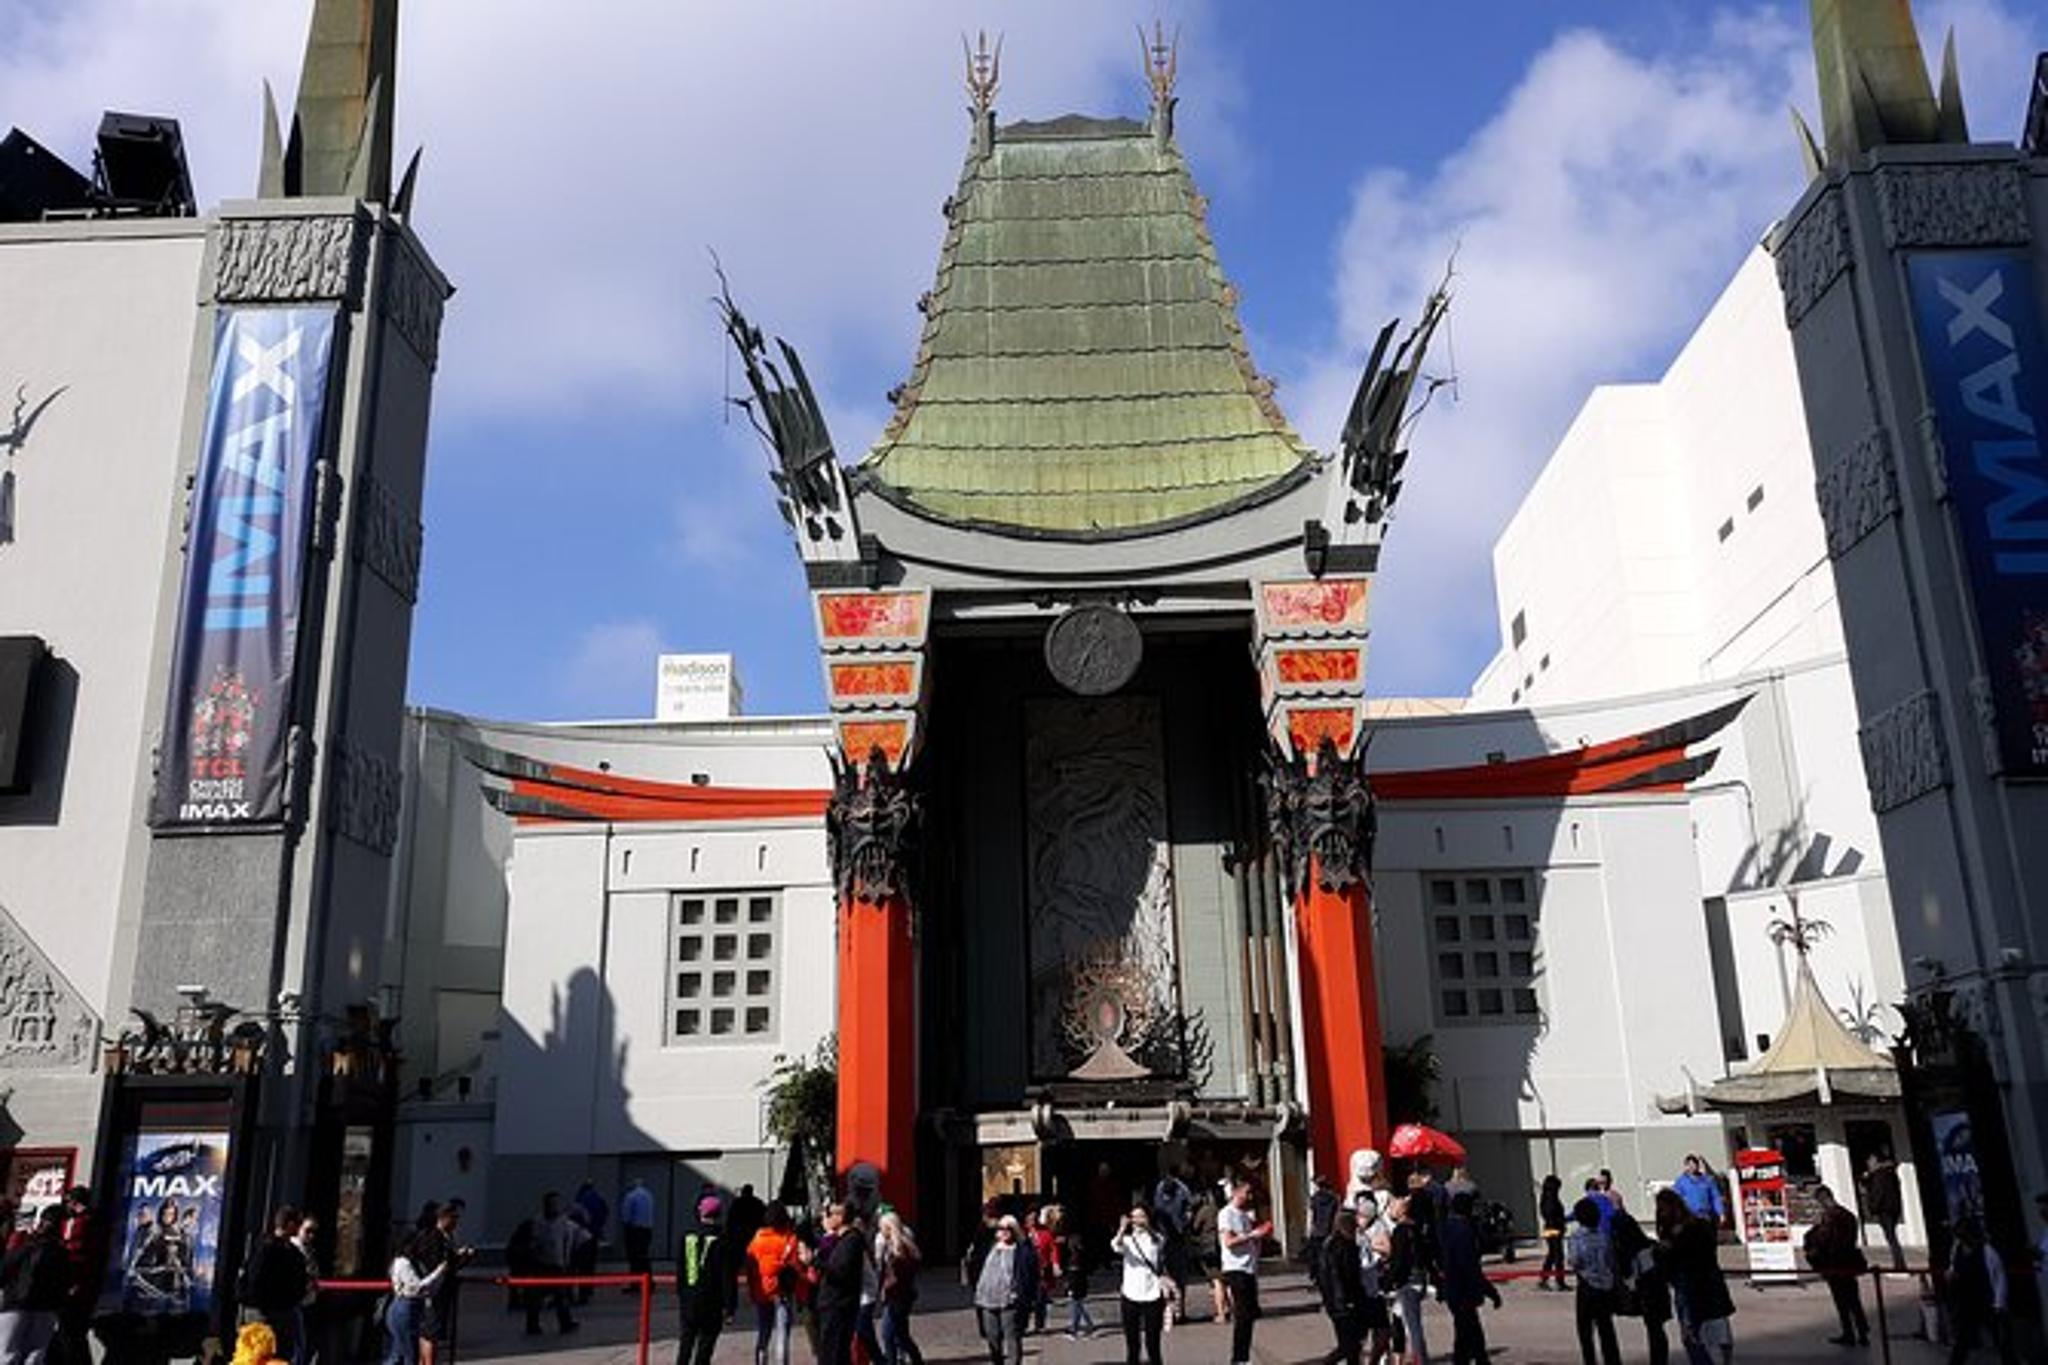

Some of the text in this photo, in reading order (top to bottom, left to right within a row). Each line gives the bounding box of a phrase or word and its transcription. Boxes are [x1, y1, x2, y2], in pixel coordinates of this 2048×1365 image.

[203, 326, 303, 630] IMAX
[1937, 268, 2048, 573] IMAX
[180, 802, 249, 820] IMAX
[193, 757, 245, 778] TCL
